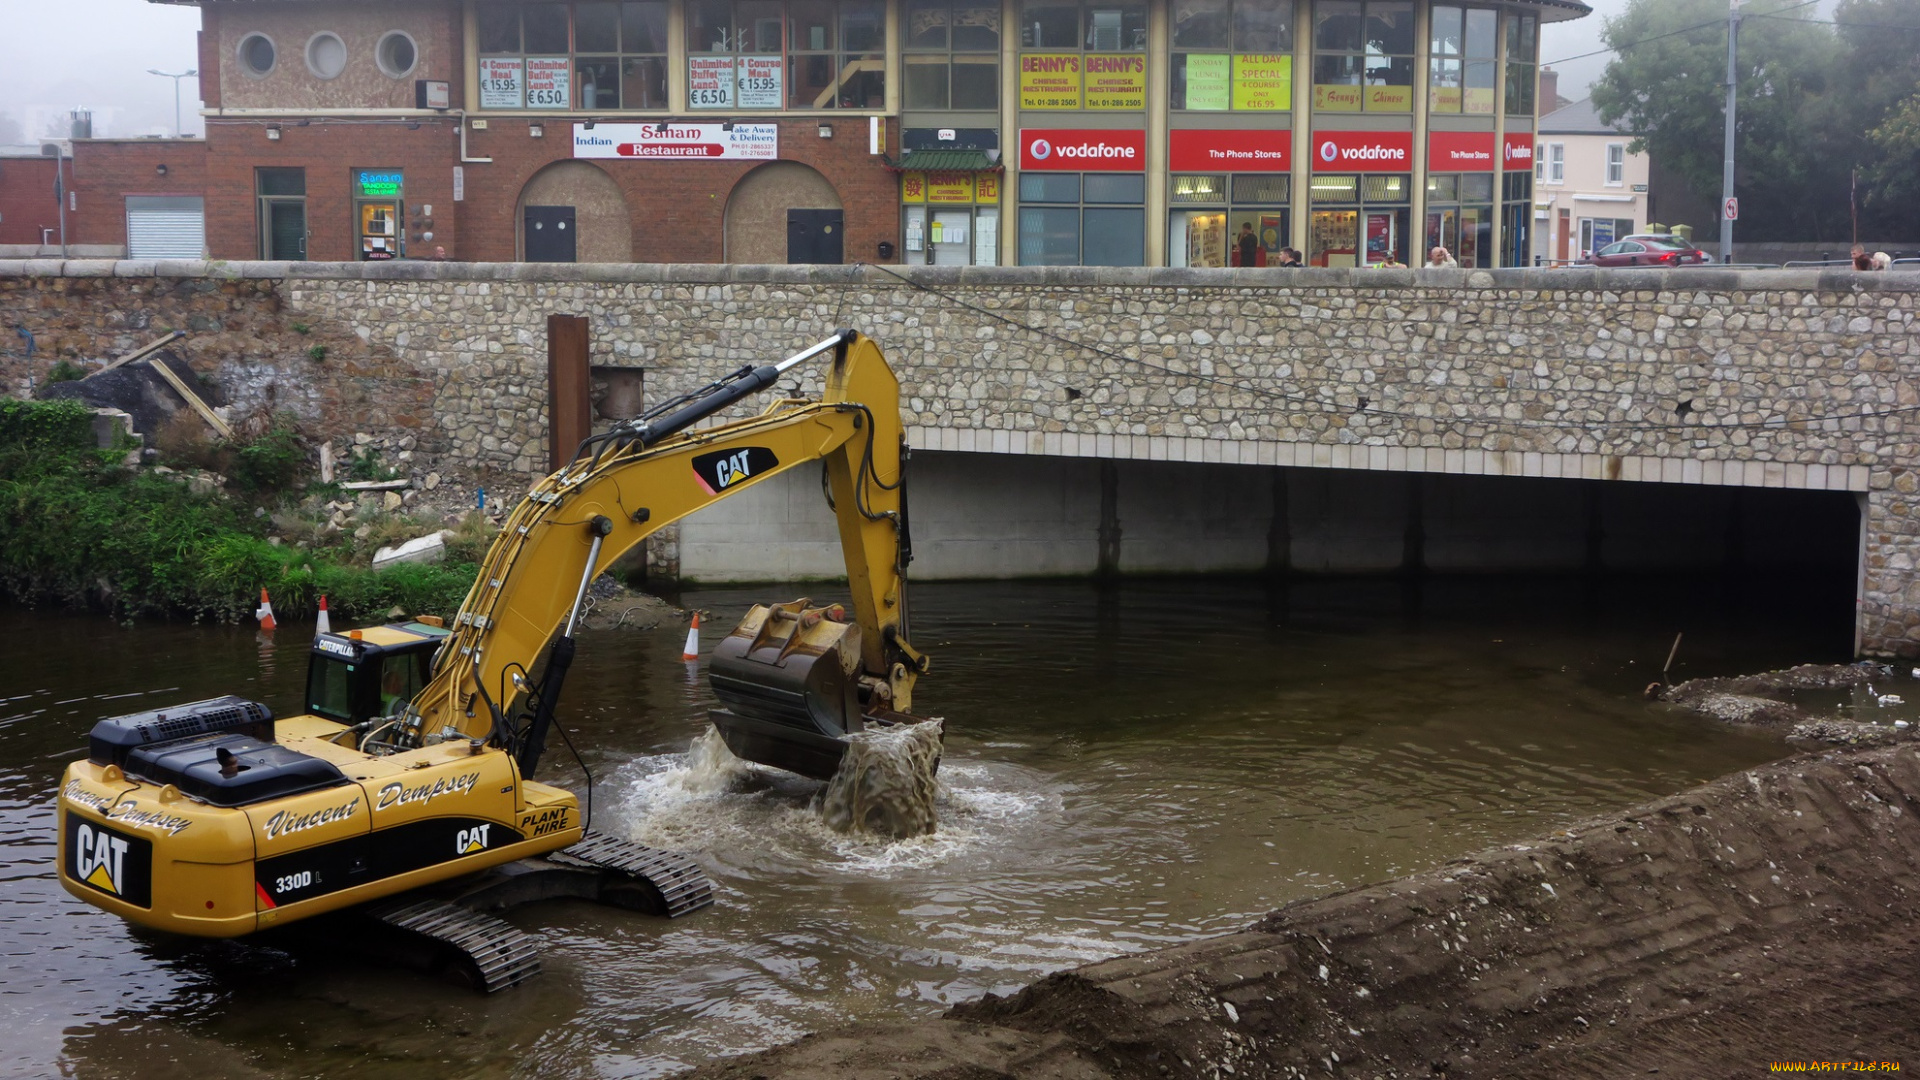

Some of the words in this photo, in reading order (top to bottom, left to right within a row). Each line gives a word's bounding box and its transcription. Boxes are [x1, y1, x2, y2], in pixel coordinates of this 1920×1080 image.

[738, 59, 745, 67] 4
[747, 58, 781, 68] Course
[1242, 54, 1259, 63] ALL
[1262, 54, 1282, 63] DAY
[480, 60, 487, 69] 4
[490, 60, 521, 69] Course
[528, 60, 568, 70] Unlimited
[690, 60, 733, 69] Unlimited
[1022, 57, 1079, 72] BENNY'S
[1086, 57, 1144, 73] BENNY'S
[490, 70, 512, 79] Meal
[528, 70, 554, 80] Buffet
[691, 70, 718, 79] Buffet
[747, 68, 771, 78] Meal
[1242, 70, 1281, 78] SPECIAL
[481, 79, 488, 90] €
[490, 79, 515, 90] 15.95
[528, 81, 554, 89] Lunch
[691, 80, 719, 89] Lunch
[738, 78, 745, 89] €
[748, 78, 775, 89] 15.95
[527, 90, 535, 104] €
[537, 90, 562, 104] 6.50
[690, 90, 698, 104] €
[701, 89, 726, 104] 6.50
[1327, 89, 1360, 105] Benny's
[1373, 91, 1404, 103] Chinese
[1247, 100, 1275, 108] €16.95
[641, 125, 702, 141] Sanam
[752, 126, 775, 134] Away
[576, 136, 613, 145] Indian
[740, 134, 775, 142] Delivery
[633, 143, 708, 155] Restaurant
[1056, 142, 1135, 158] vodafone
[1209, 150, 1225, 158] The
[1226, 150, 1253, 158] Phone
[1254, 150, 1282, 158] Stores
[1341, 144, 1405, 160] vodafone
[1450, 150, 1459, 158] The
[1474, 151, 1490, 159] Stores
[1511, 144, 1531, 158] vodafone
[360, 172, 402, 183] Sanam
[929, 174, 971, 186] BENNY'S
[978, 178, 997, 198] 記
[716, 449, 750, 487] CAT
[62, 778, 112, 811] Vincent
[106, 800, 193, 837] Dempsey
[263, 796, 360, 840] Vincent
[375, 771, 480, 812] Dempsey
[521, 806, 569, 828] PLANT
[533, 818, 568, 836] HIRE
[456, 823, 491, 854] CAT
[77, 823, 128, 896] CAT
[276, 870, 312, 893] 330D
